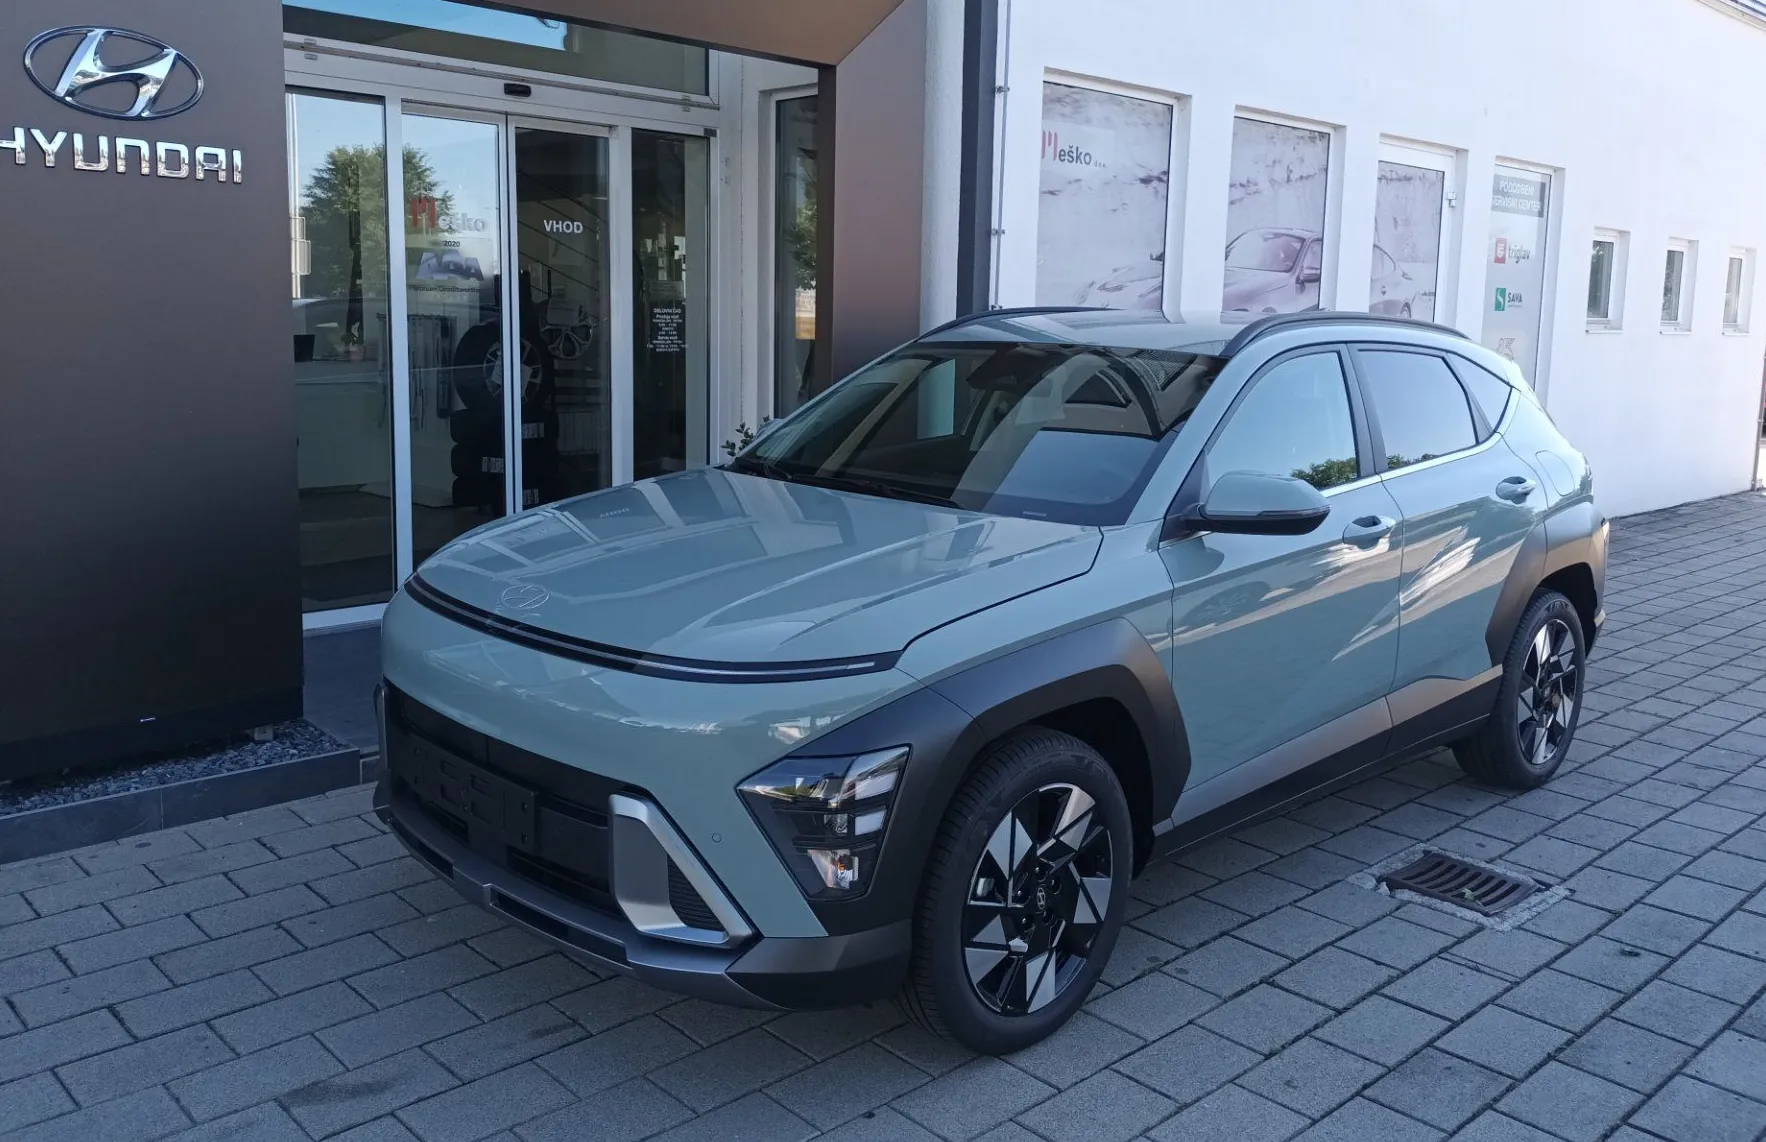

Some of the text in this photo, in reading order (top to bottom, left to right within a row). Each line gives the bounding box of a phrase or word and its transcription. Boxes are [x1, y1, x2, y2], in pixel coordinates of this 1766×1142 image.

[543, 219, 583, 234] VHOD
[1508, 244, 1531, 263] triglav
[1507, 291, 1523, 304] SAVA
